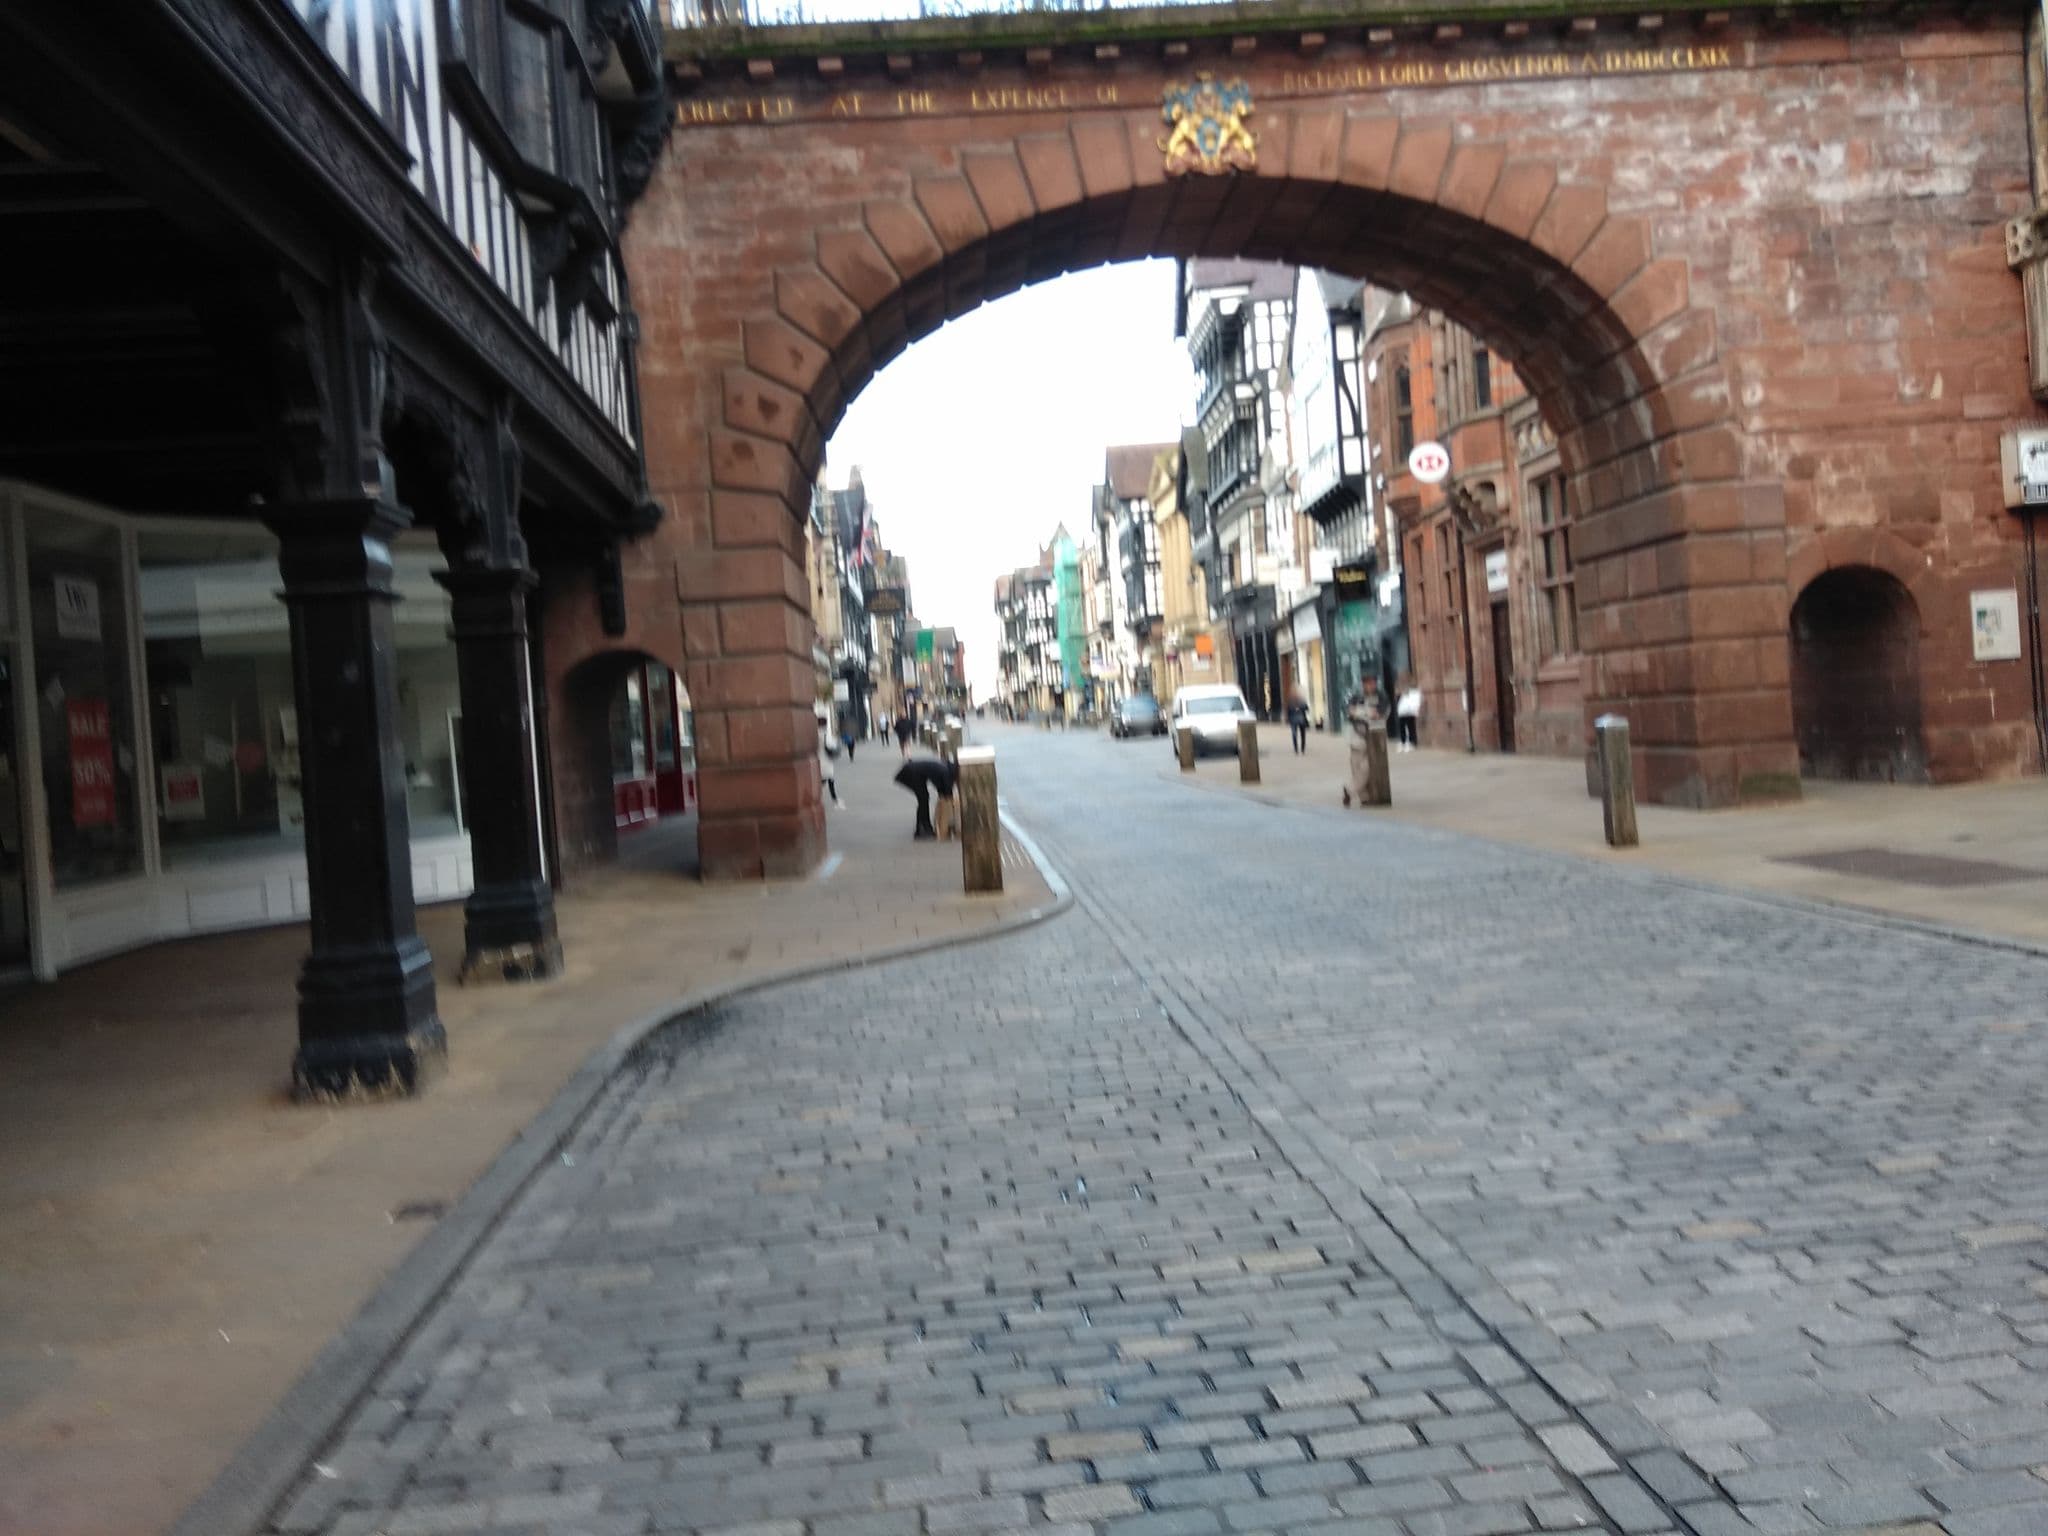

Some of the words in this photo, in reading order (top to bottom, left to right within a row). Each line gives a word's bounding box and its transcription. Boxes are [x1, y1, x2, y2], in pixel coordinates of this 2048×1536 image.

[1378, 62, 1434, 86] LORD
[1444, 53, 1570, 81] GROSVENOR
[831, 93, 862, 116] AT
[897, 90, 936, 113] THE
